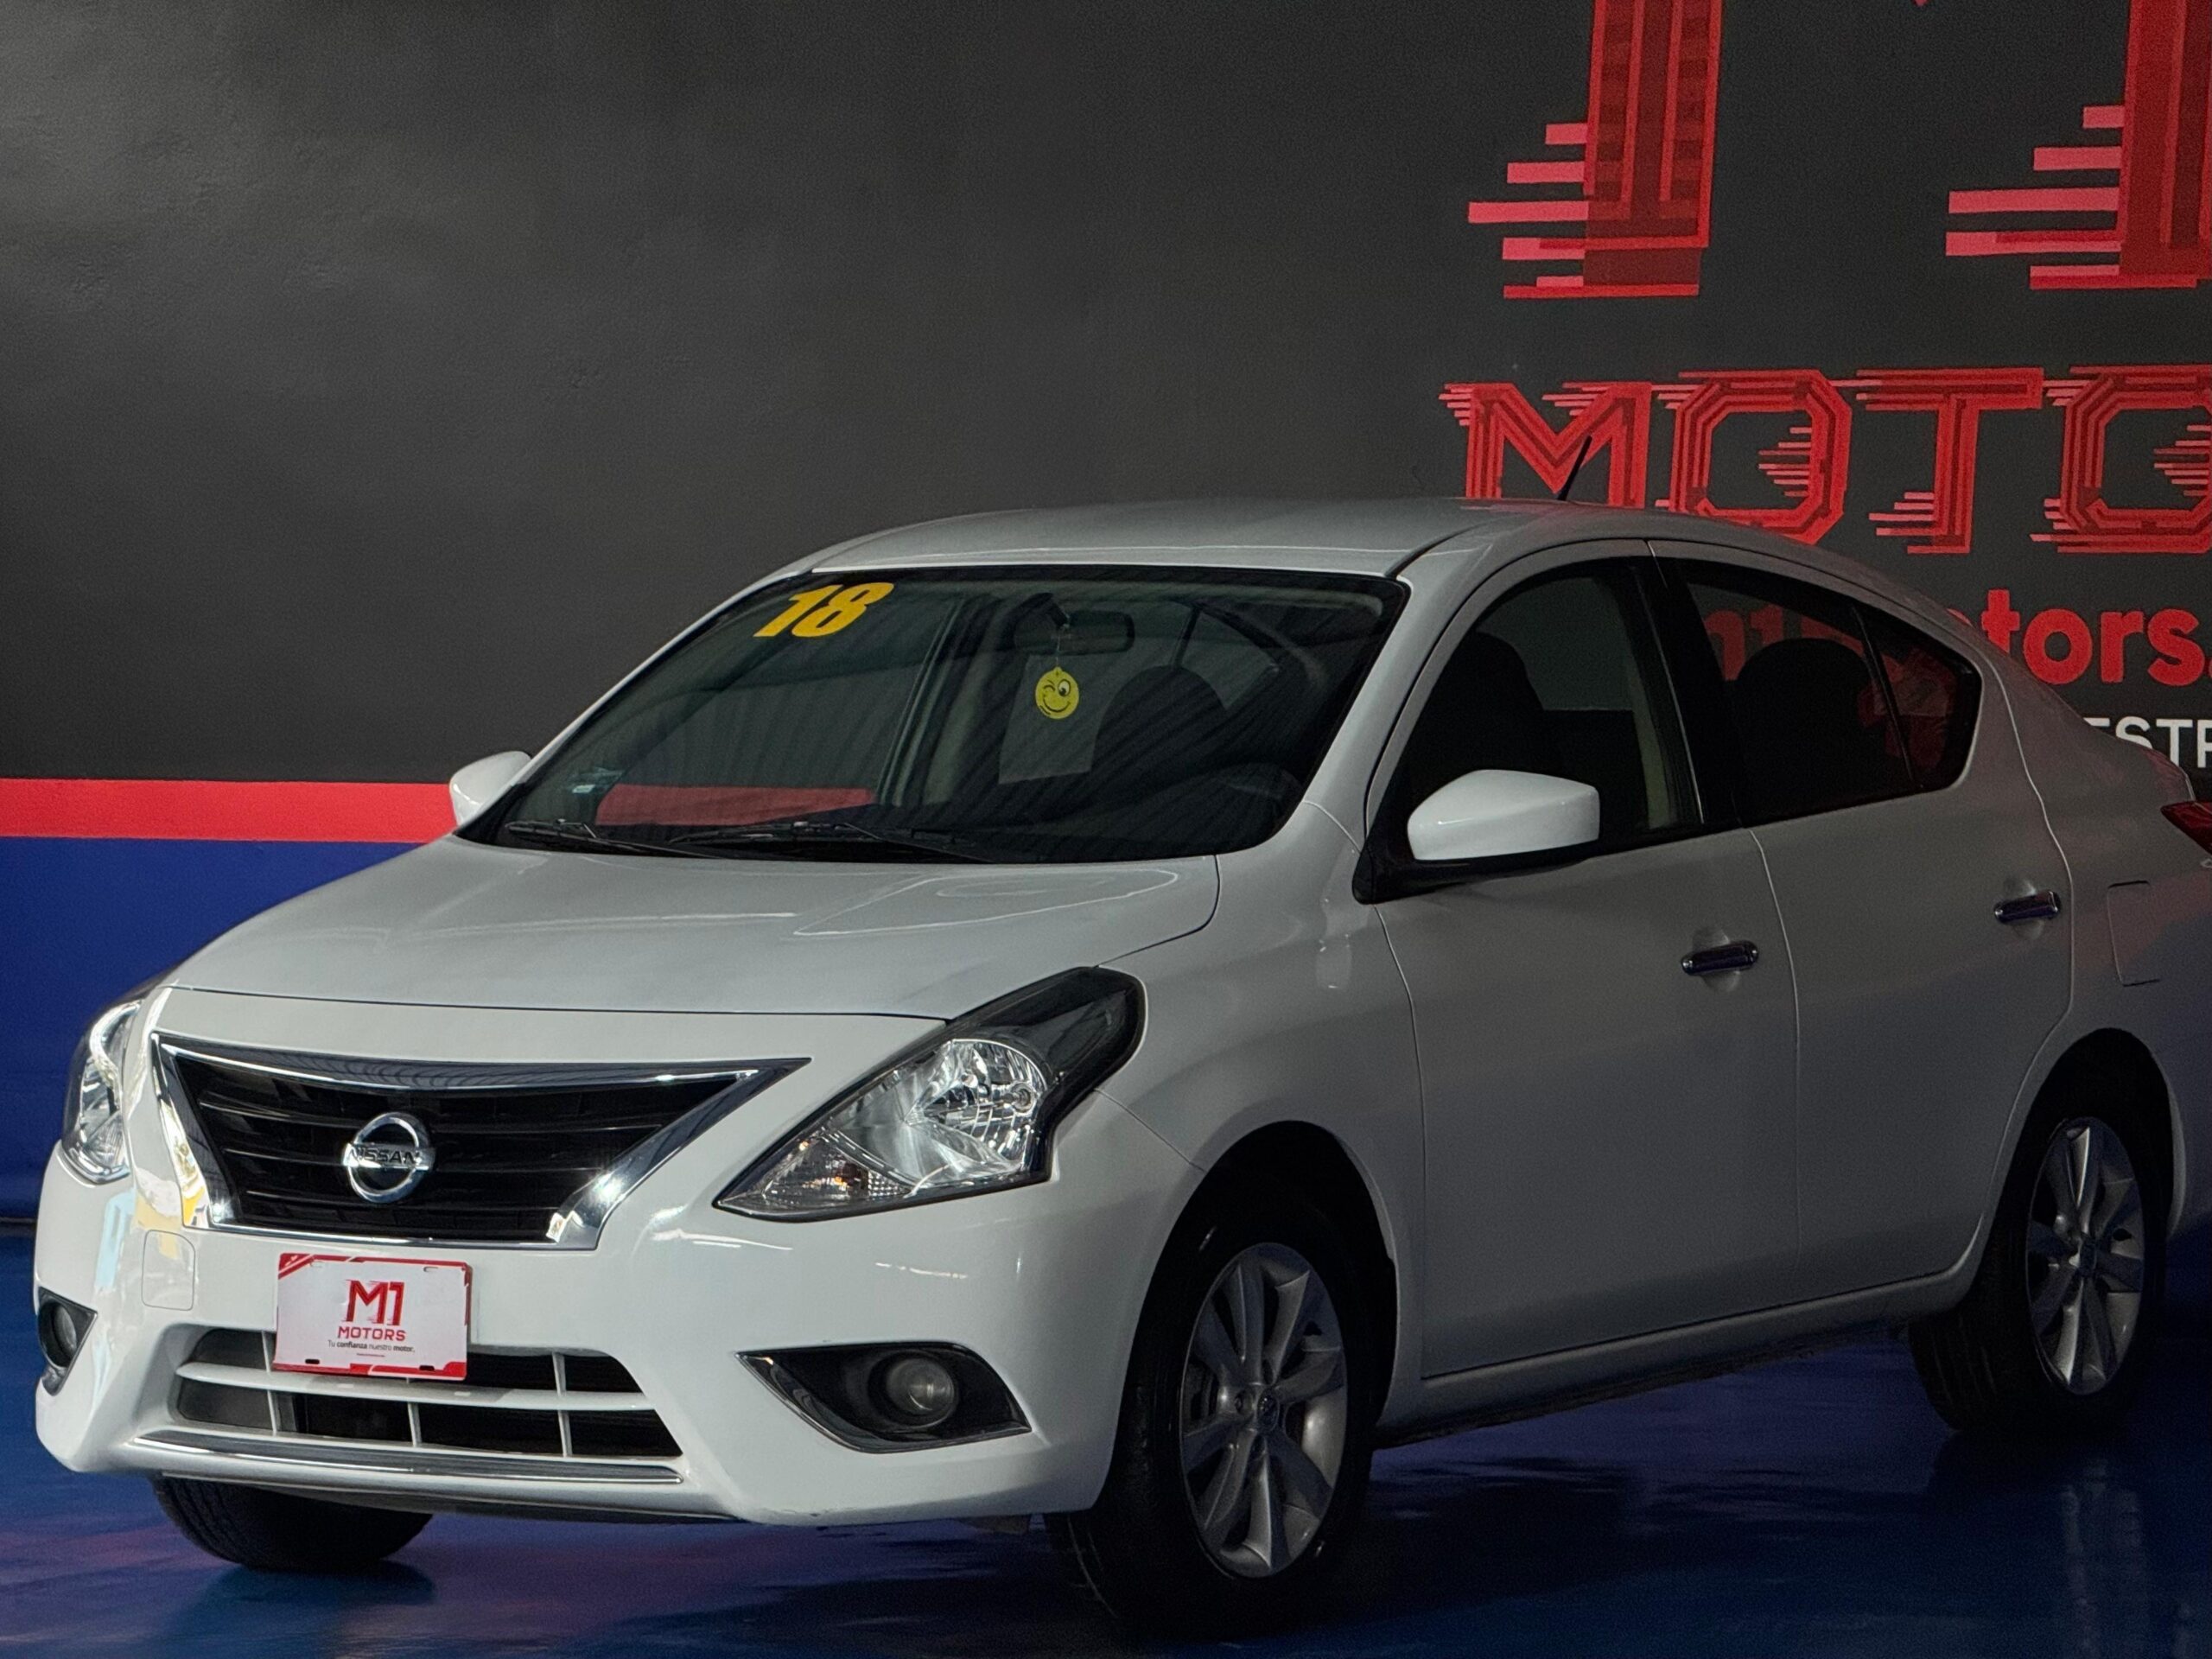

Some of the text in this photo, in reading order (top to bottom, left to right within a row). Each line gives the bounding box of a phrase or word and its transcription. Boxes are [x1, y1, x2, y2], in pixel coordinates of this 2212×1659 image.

[753, 582, 895, 638] 18
[347, 1146, 422, 1165] NISSAN
[341, 1279, 405, 1326] M1
[337, 1325, 406, 1342] MOTORS
[336, 1341, 368, 1350] confianza
[368, 1343, 392, 1351] nuestro
